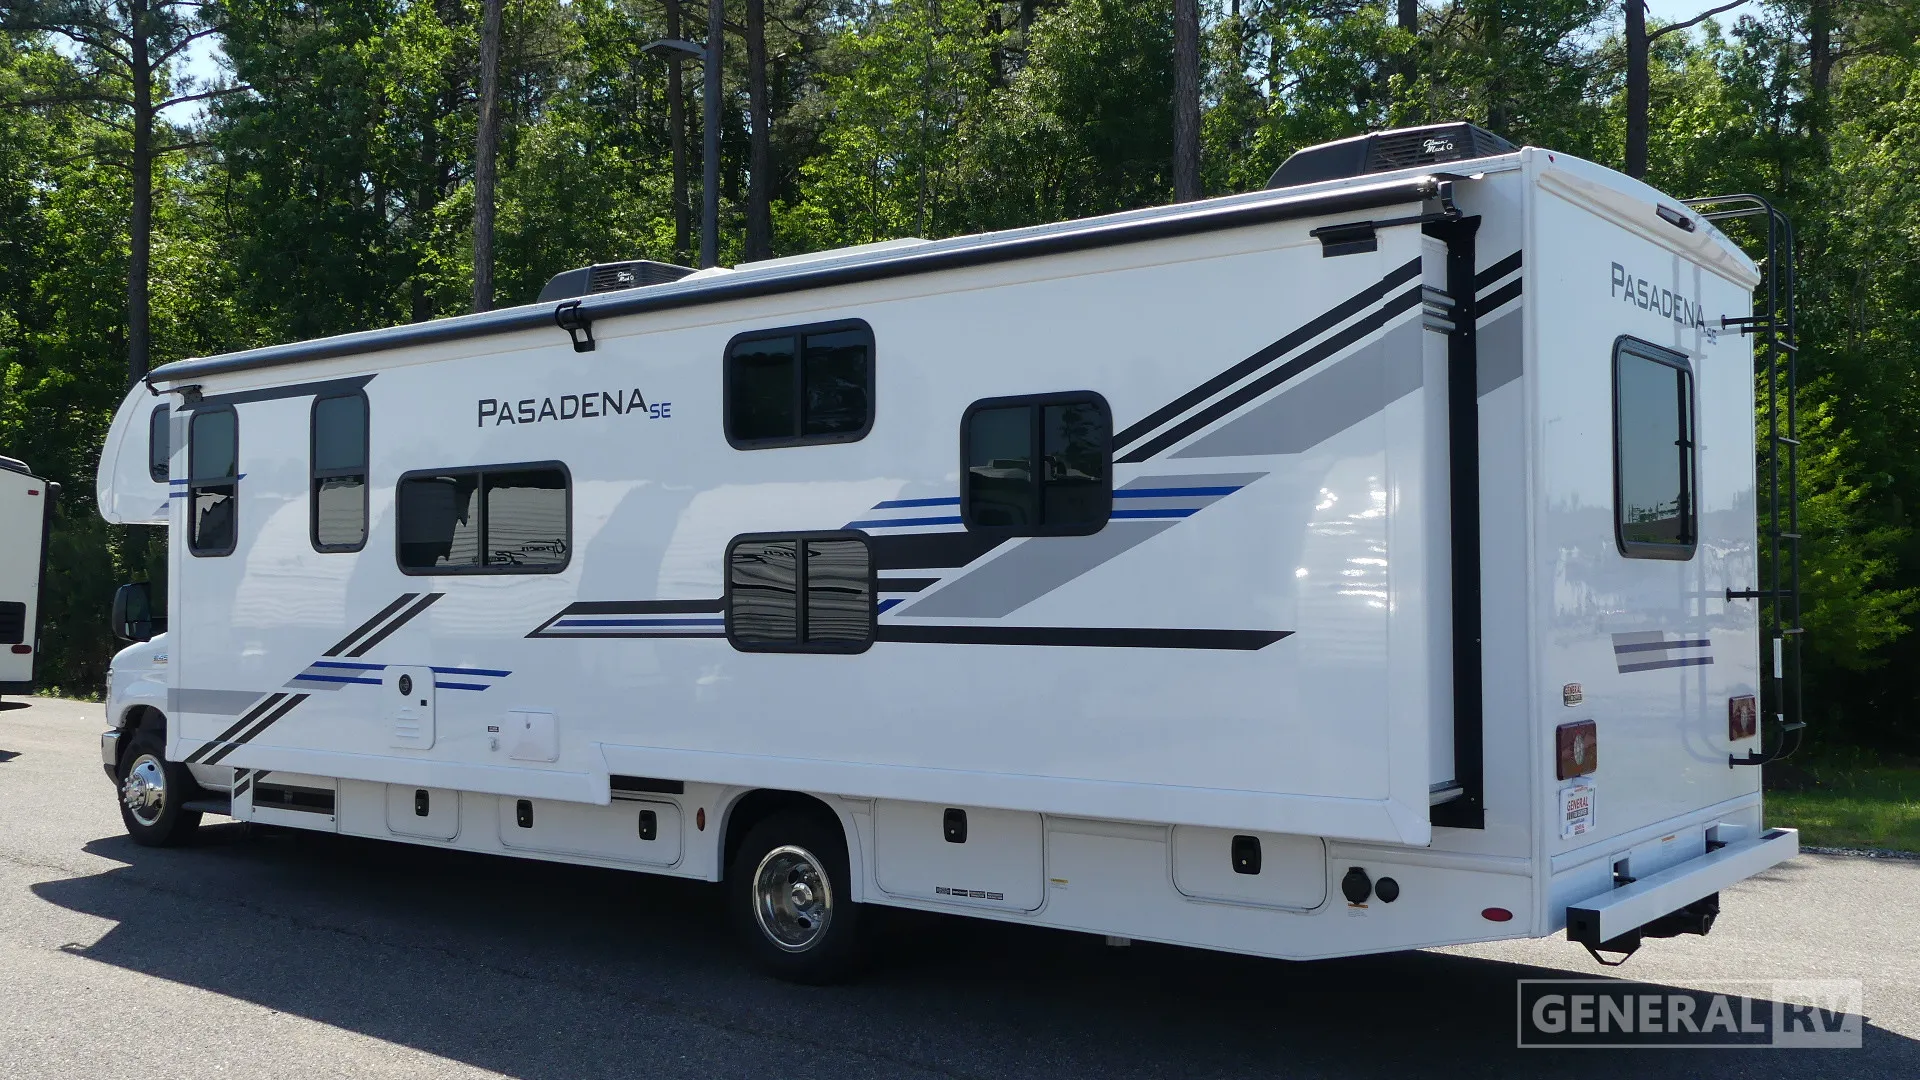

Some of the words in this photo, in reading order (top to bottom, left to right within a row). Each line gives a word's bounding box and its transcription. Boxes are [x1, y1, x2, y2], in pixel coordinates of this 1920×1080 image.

[1611, 261, 1706, 333] PASADENA
[1706, 327, 1717, 346] SE
[478, 388, 649, 428] PASADENA
[649, 402, 672, 420] SE
[1567, 796, 1589, 812] GENERAL
